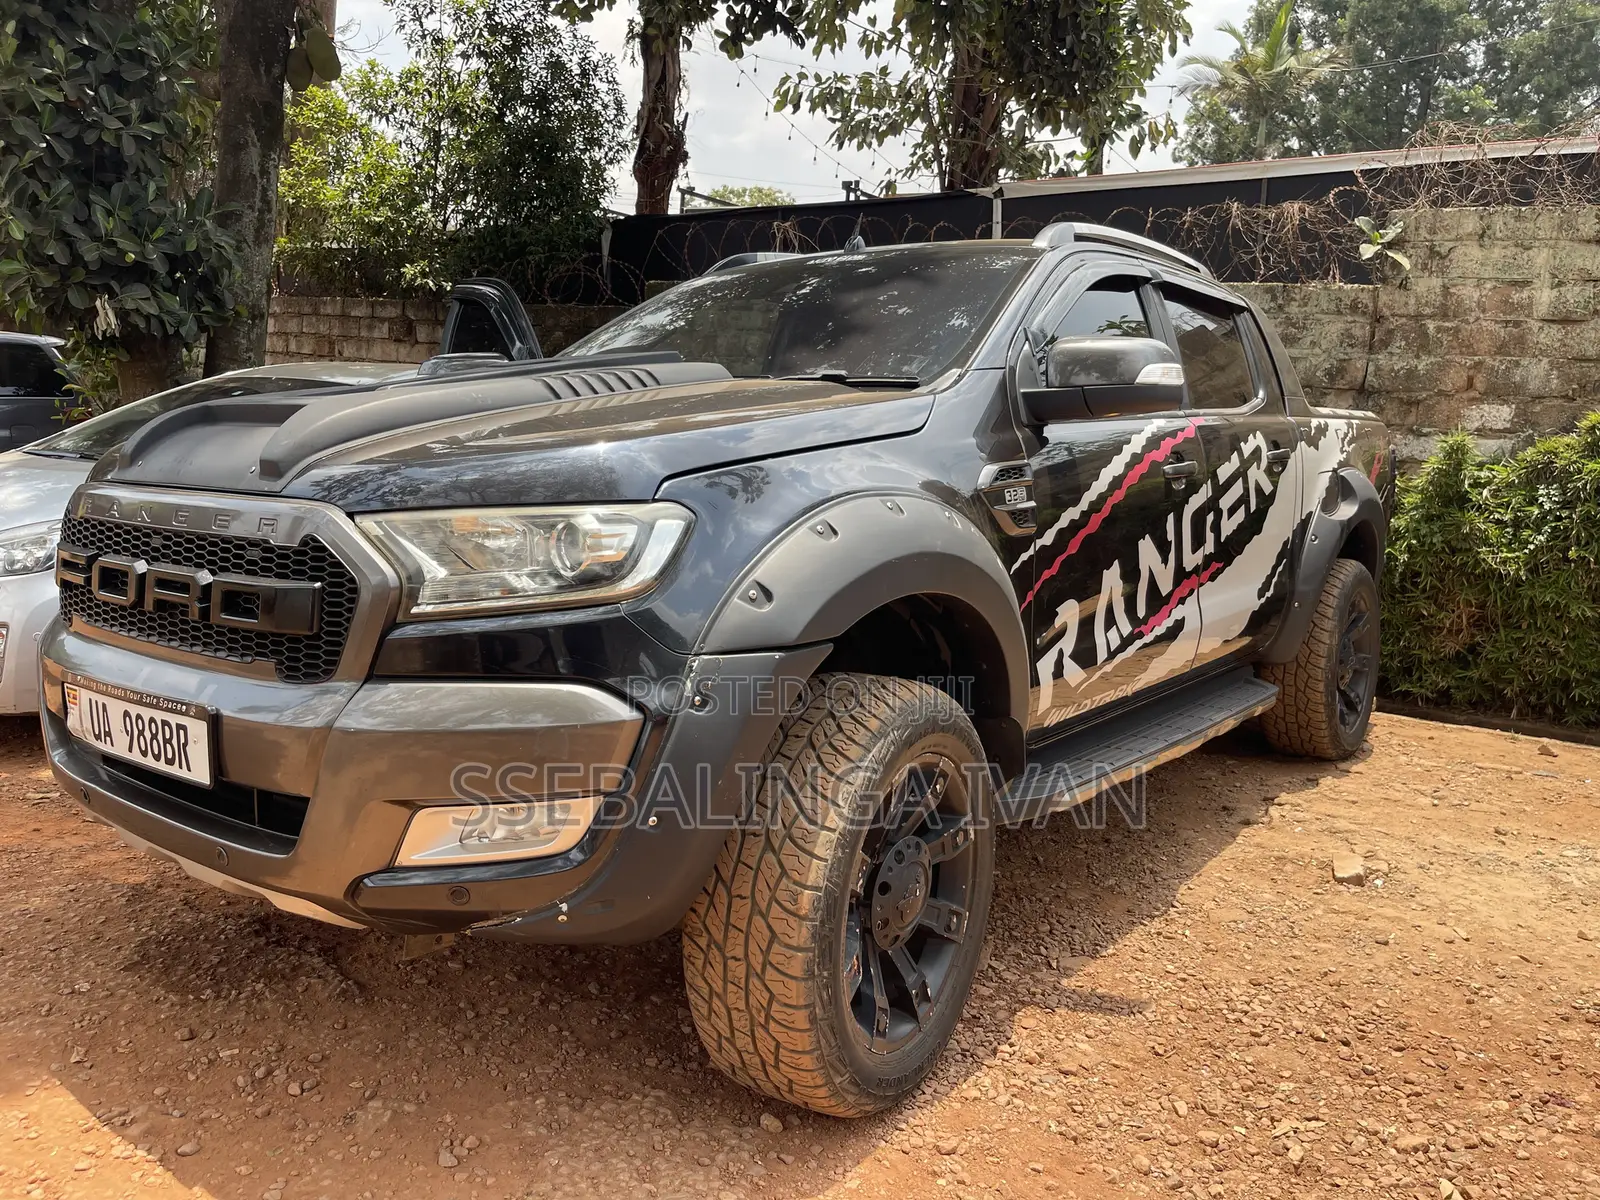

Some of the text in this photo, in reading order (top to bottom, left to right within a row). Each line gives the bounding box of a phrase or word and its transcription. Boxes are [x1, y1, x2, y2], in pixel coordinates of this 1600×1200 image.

[83, 493, 279, 535] RANGER
[55, 543, 322, 635] FORD
[1036, 430, 1274, 716] RANGER
[80, 676, 97, 690] Making
[98, 681, 106, 692] the
[108, 685, 125, 697] Roads
[126, 689, 141, 701] Your
[142, 693, 157, 705] Safe
[1043, 680, 1138, 728] WILDTRAK
[88, 697, 192, 773] UA 988BR
